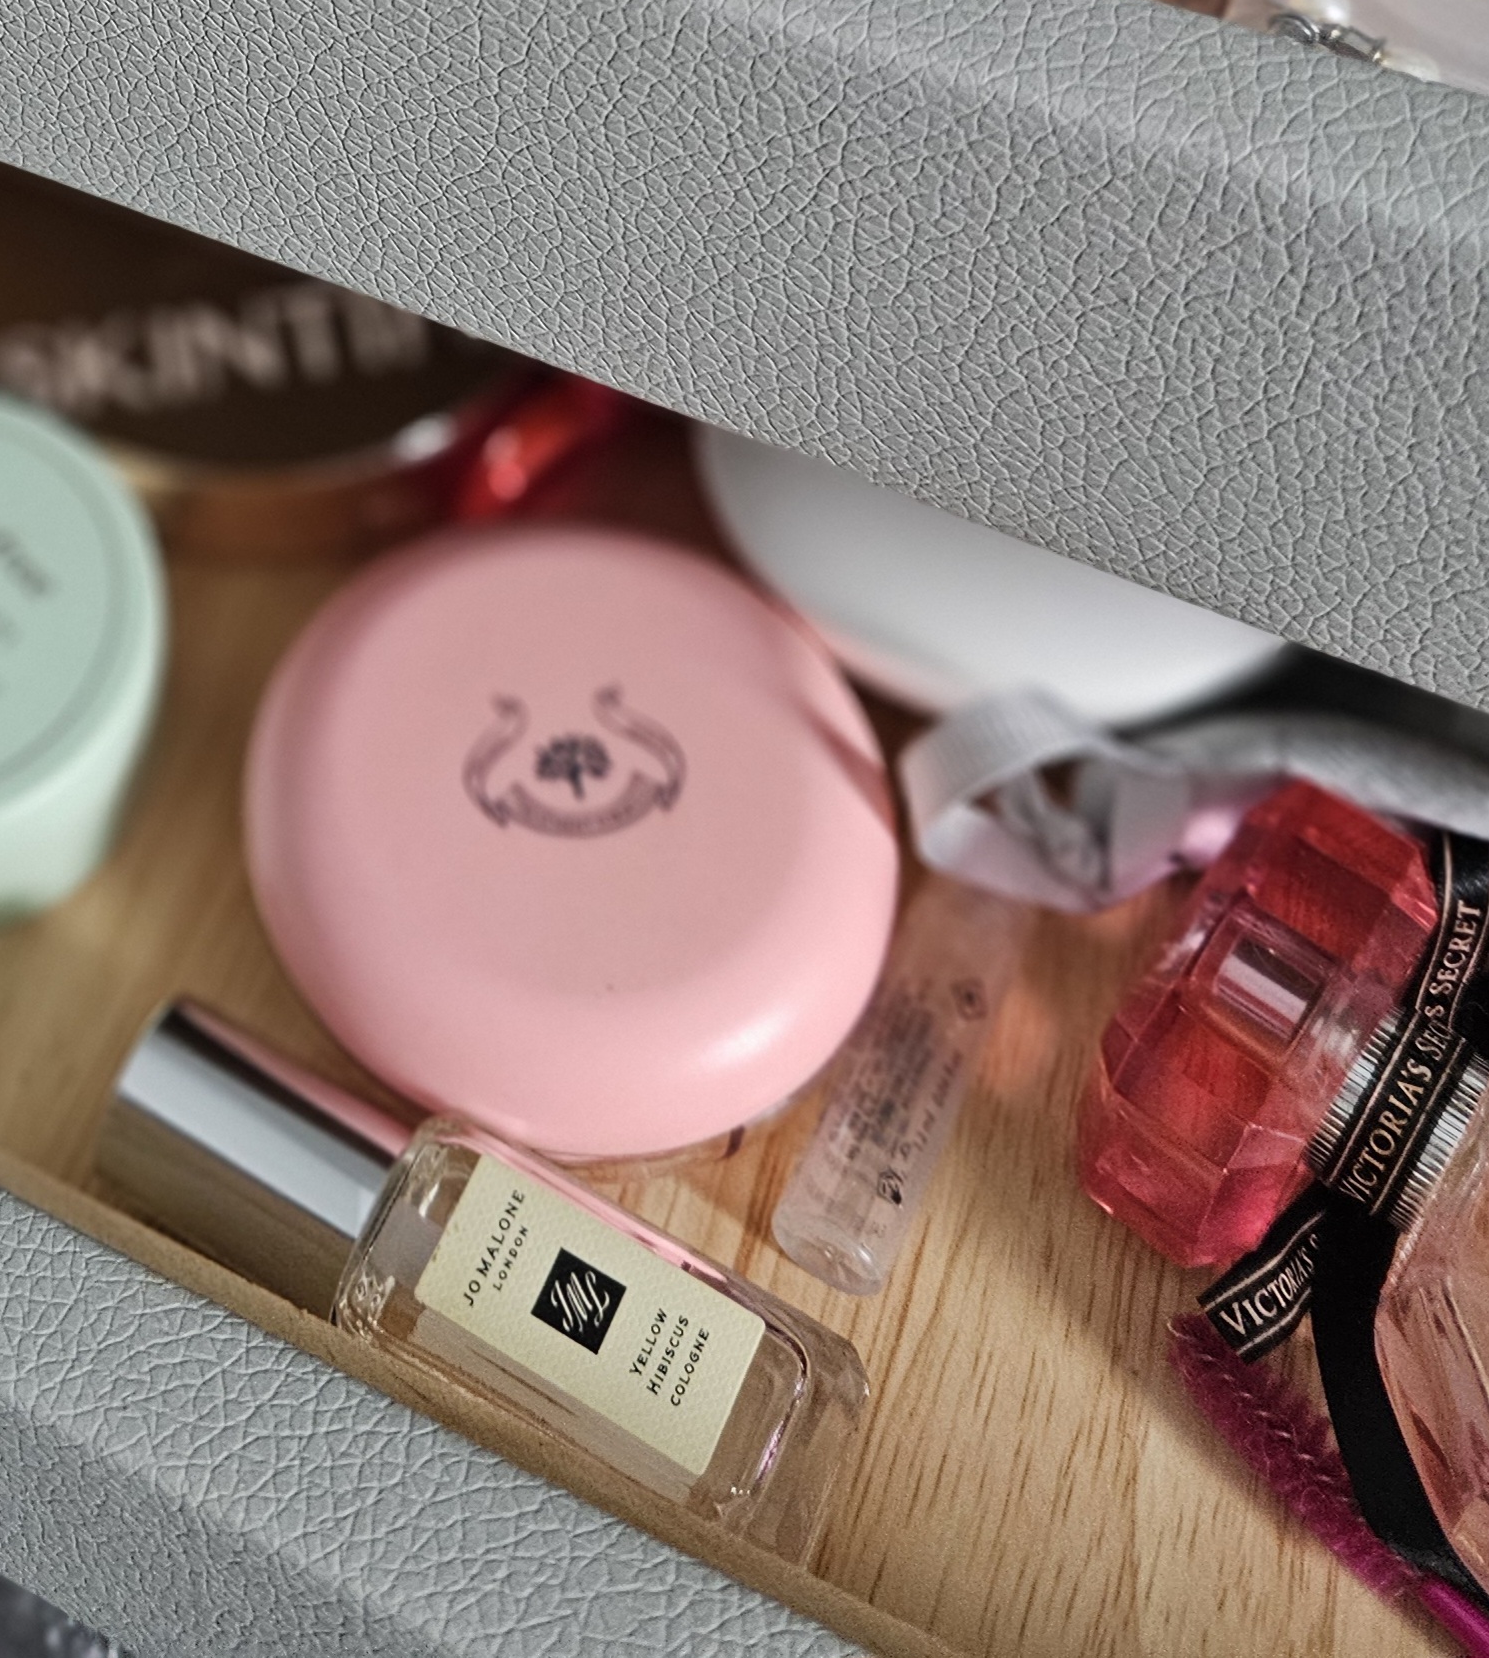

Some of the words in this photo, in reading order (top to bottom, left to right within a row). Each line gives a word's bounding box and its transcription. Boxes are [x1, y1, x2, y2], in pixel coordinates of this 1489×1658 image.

[1428, 899, 1482, 996] SECRET
[1338, 1057, 1433, 1203] VICTORIA'S
[463, 1279, 481, 1307] JO
[476, 1188, 525, 1278] MALONE
[493, 1224, 529, 1291] LONDON
[1219, 1247, 1315, 1336] VICTORIA'S
[629, 1307, 668, 1377] YELLOW
[646, 1314, 690, 1397] HIBISCUS
[670, 1327, 711, 1408] COLOGNE
